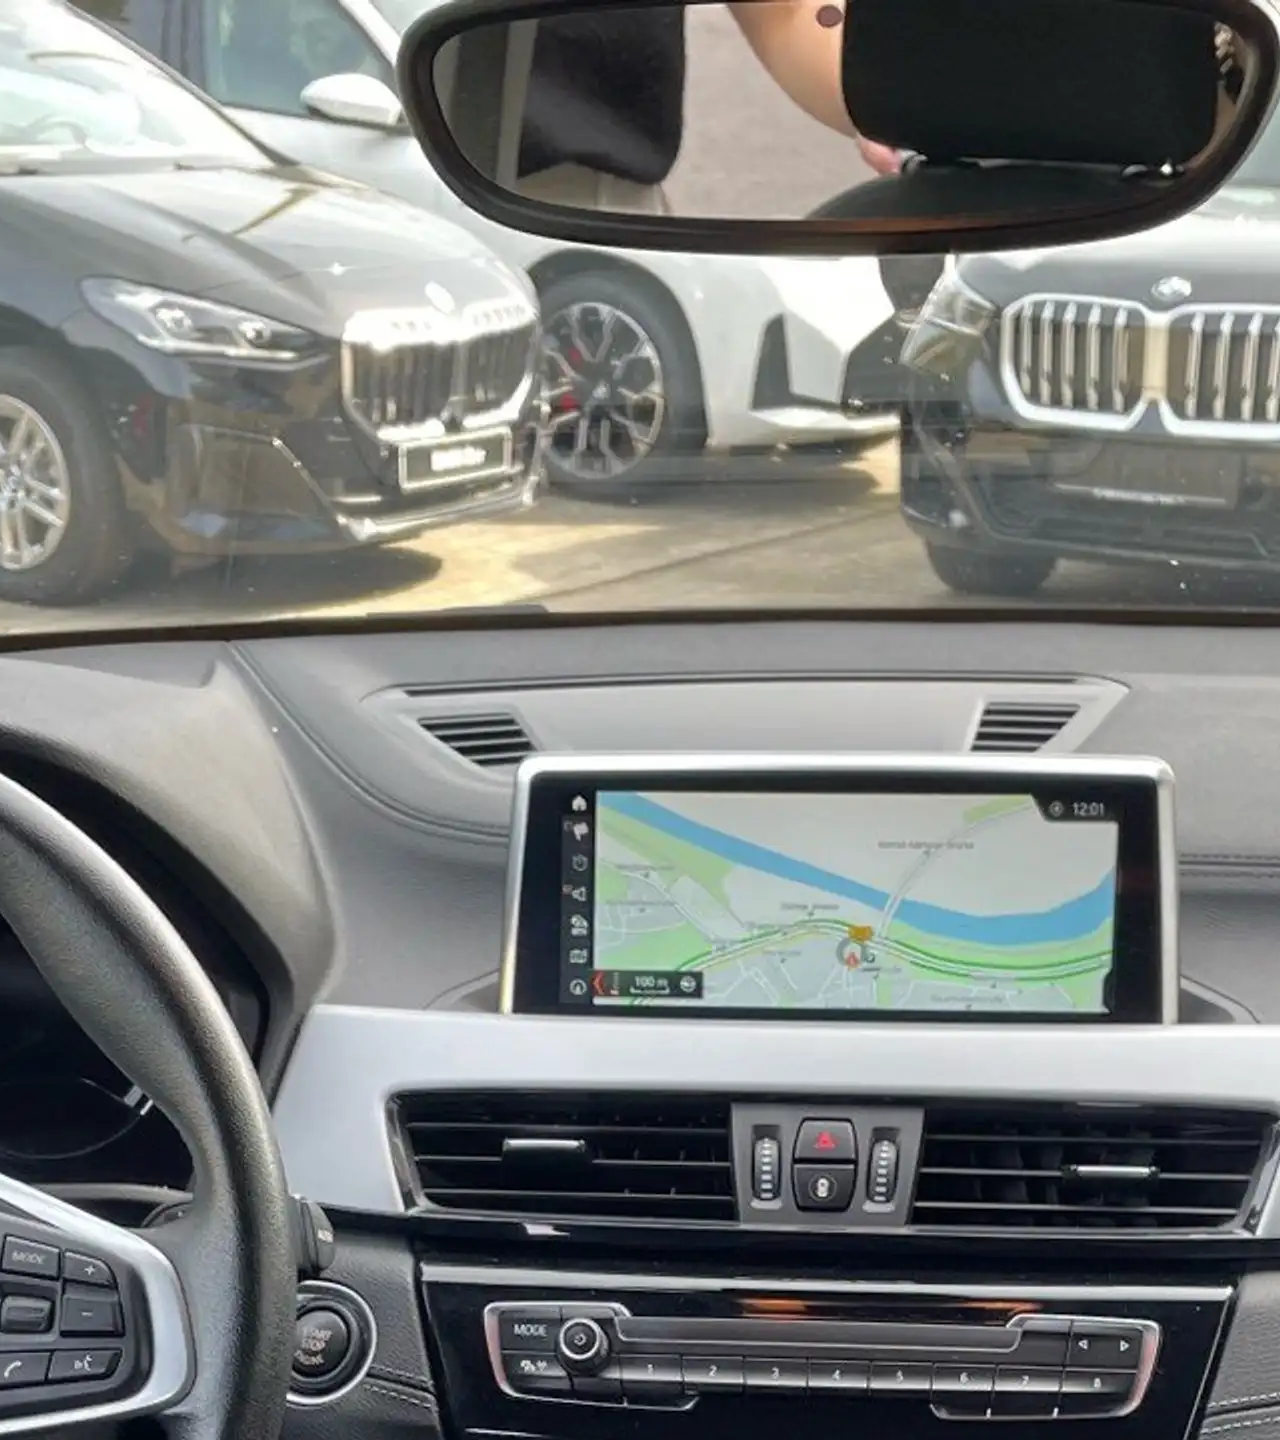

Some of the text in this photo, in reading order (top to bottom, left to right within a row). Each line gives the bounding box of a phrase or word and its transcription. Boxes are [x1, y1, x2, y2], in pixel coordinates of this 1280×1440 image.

[1072, 801, 1105, 817] 12:01
[634, 975, 656, 988] 100
[513, 1323, 548, 1337] MODE
[708, 1364, 718, 1377] 2
[770, 1366, 780, 1380] 3
[1021, 1374, 1030, 1387] 7
